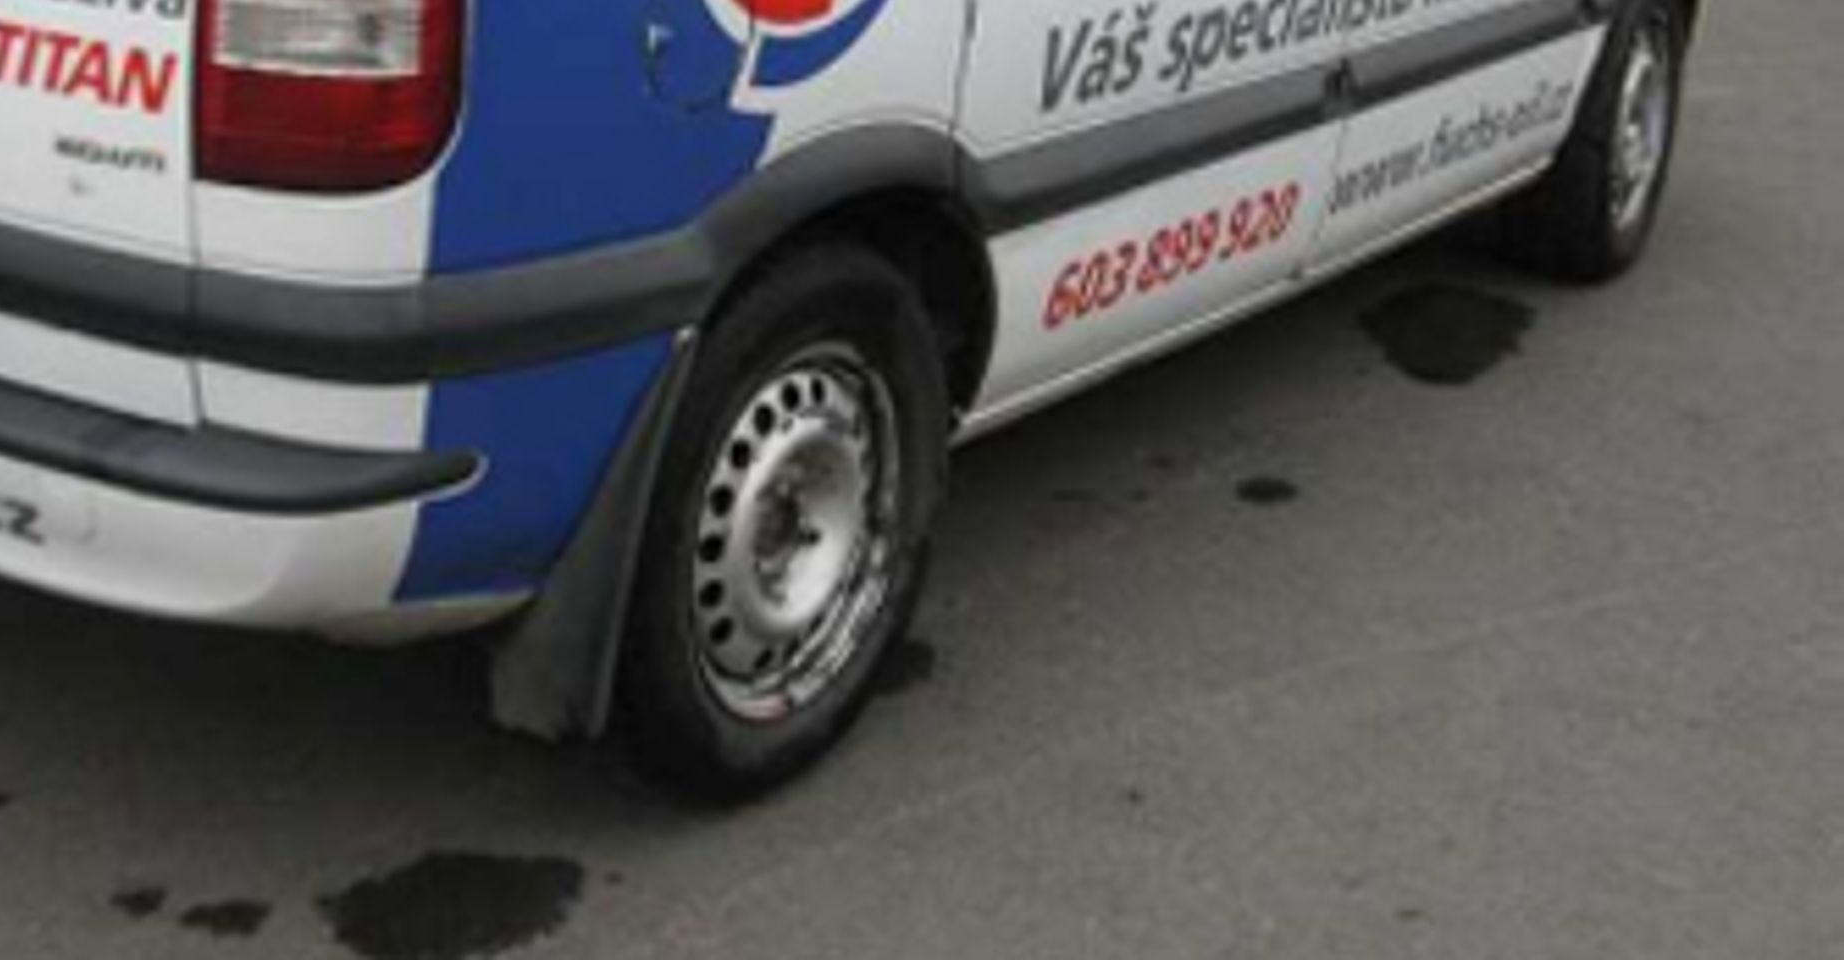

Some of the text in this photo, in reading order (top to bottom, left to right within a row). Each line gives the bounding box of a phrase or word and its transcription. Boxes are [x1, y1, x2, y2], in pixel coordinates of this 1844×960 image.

[1041, 180, 1302, 332] 603 899 920
